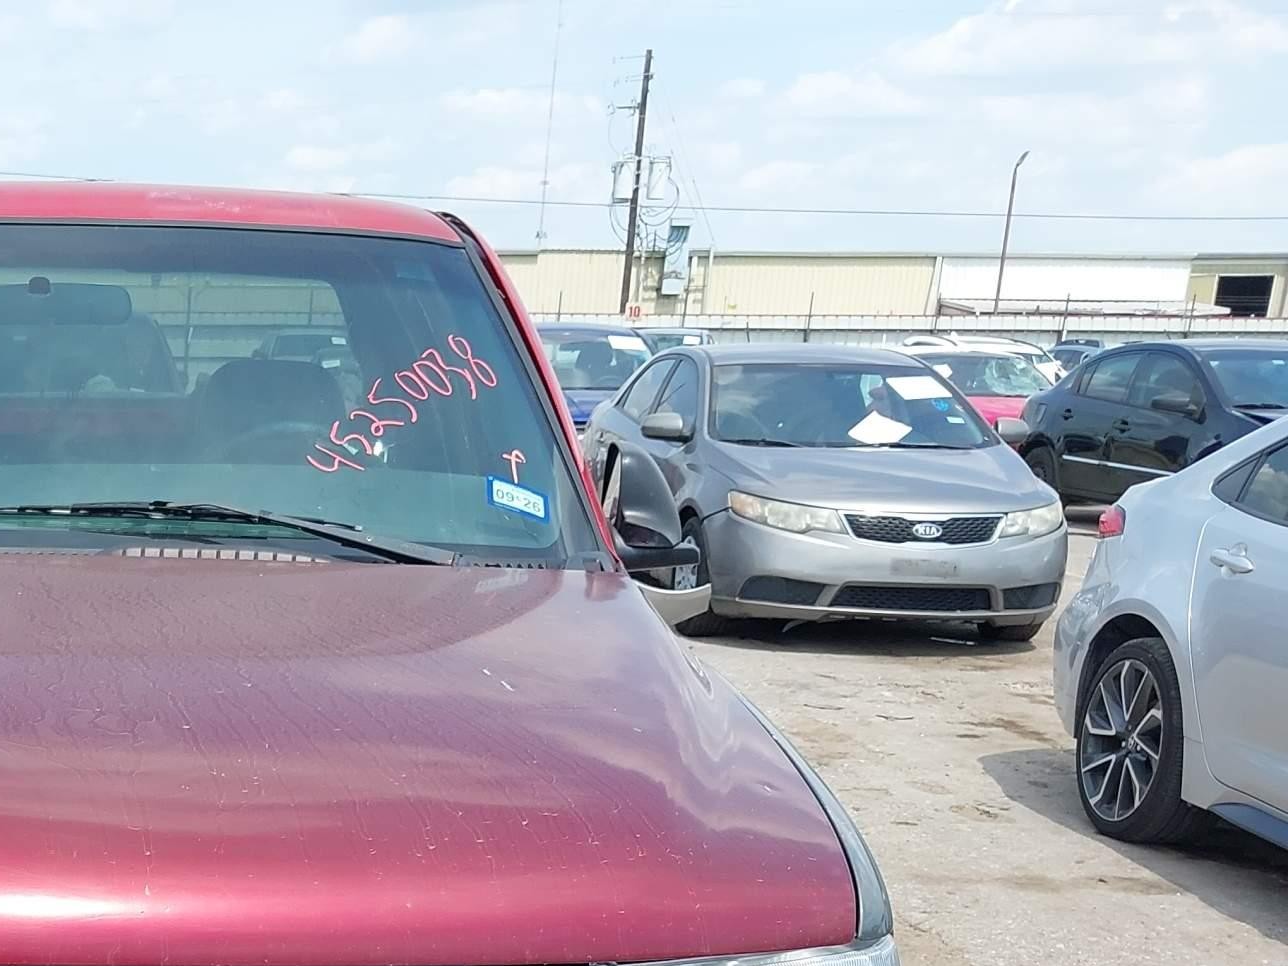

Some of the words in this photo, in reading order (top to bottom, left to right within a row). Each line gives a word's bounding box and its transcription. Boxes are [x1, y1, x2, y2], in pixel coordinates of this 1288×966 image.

[628, 305, 641, 318] 10
[306, 334, 497, 472] 45250038
[496, 488, 515, 503] 09
[523, 498, 541, 513] 26
